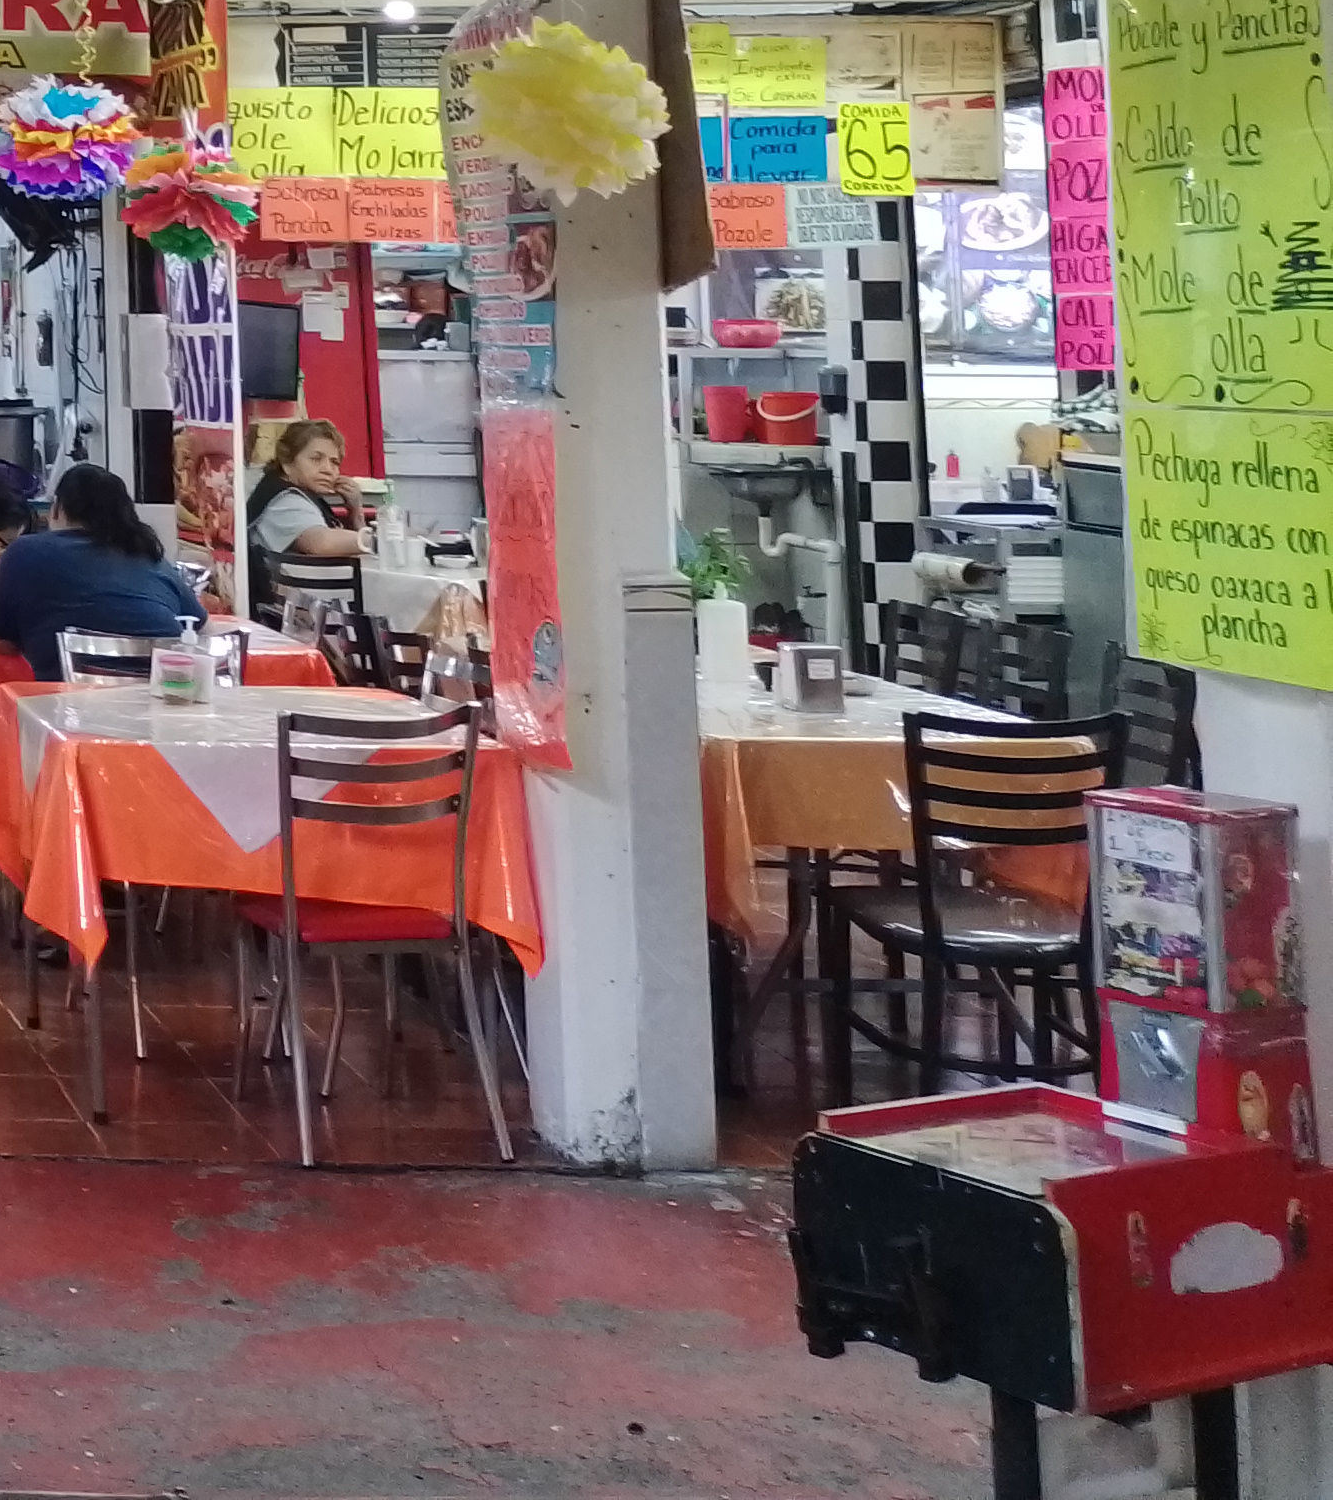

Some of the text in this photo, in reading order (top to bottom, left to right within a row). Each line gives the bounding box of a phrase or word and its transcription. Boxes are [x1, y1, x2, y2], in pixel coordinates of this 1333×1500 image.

[1191, 21, 1209, 75] y
[730, 117, 818, 139] Comida
[840, 103, 903, 118] COMIDA
[1124, 93, 1263, 163] Caldo de
[751, 143, 798, 160] para
[350, 201, 428, 219] Enchiladas
[1170, 177, 1241, 225] Pollo
[364, 222, 423, 239] Suizas
[1132, 244, 1267, 306] Mole de
[1211, 316, 1267, 374] olla
[1130, 416, 1320, 508] Pechuga rellena
[1139, 498, 1329, 560] de espinacas con
[1145, 567, 1201, 611] queso
[1211, 575, 1294, 607] oaxaca
[1303, 581, 1319, 610] a
[1201, 603, 1288, 657] plancha
